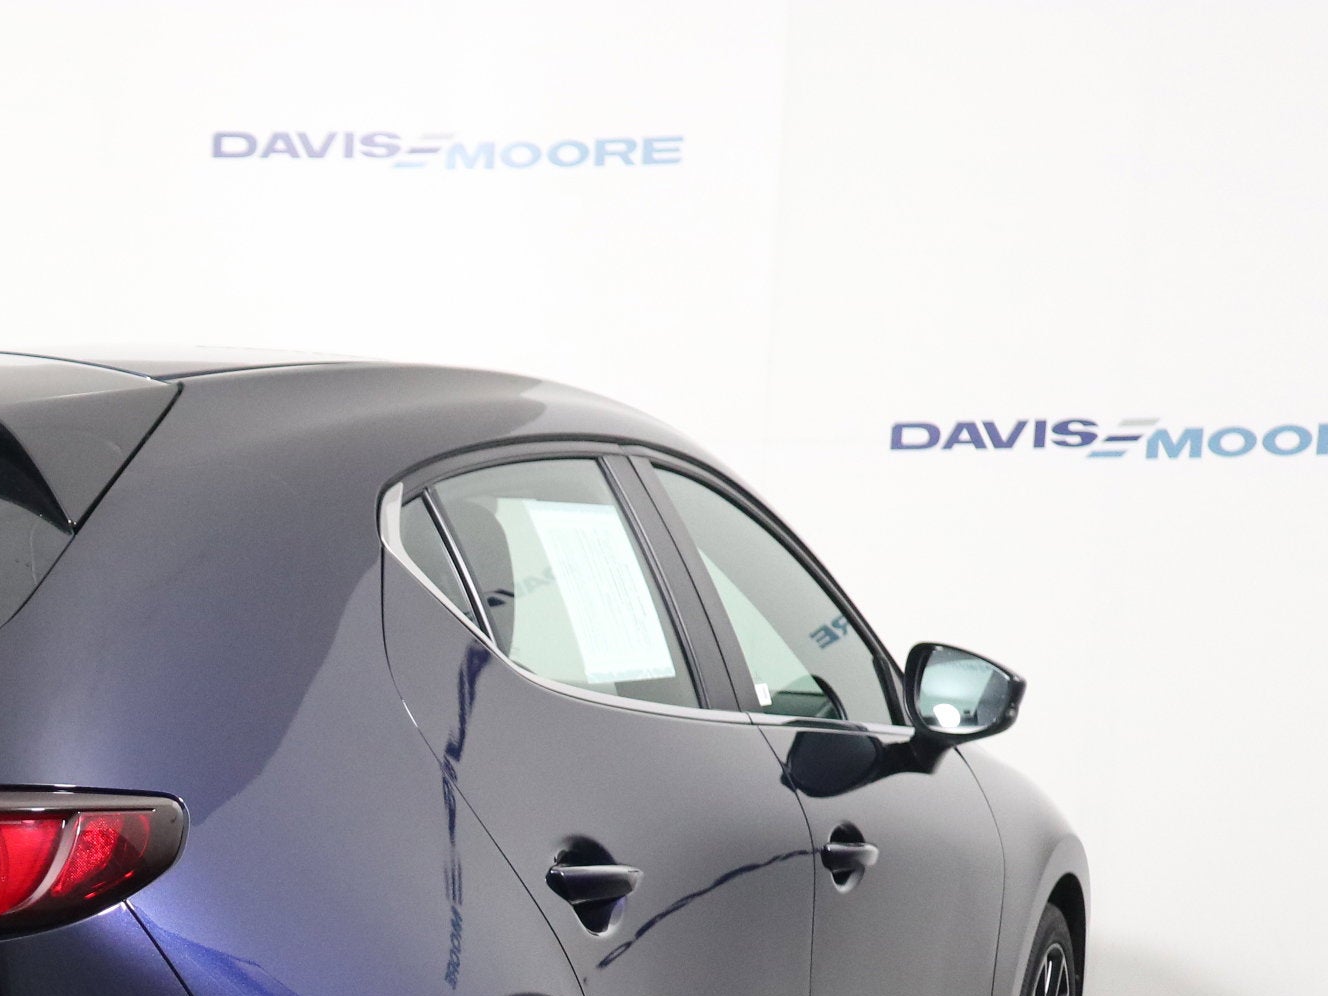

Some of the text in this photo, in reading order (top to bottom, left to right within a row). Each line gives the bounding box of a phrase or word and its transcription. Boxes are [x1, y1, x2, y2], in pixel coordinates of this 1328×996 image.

[211, 130, 684, 169] DAVIS MOORE
[890, 418, 1328, 460] DAVIS MOO
